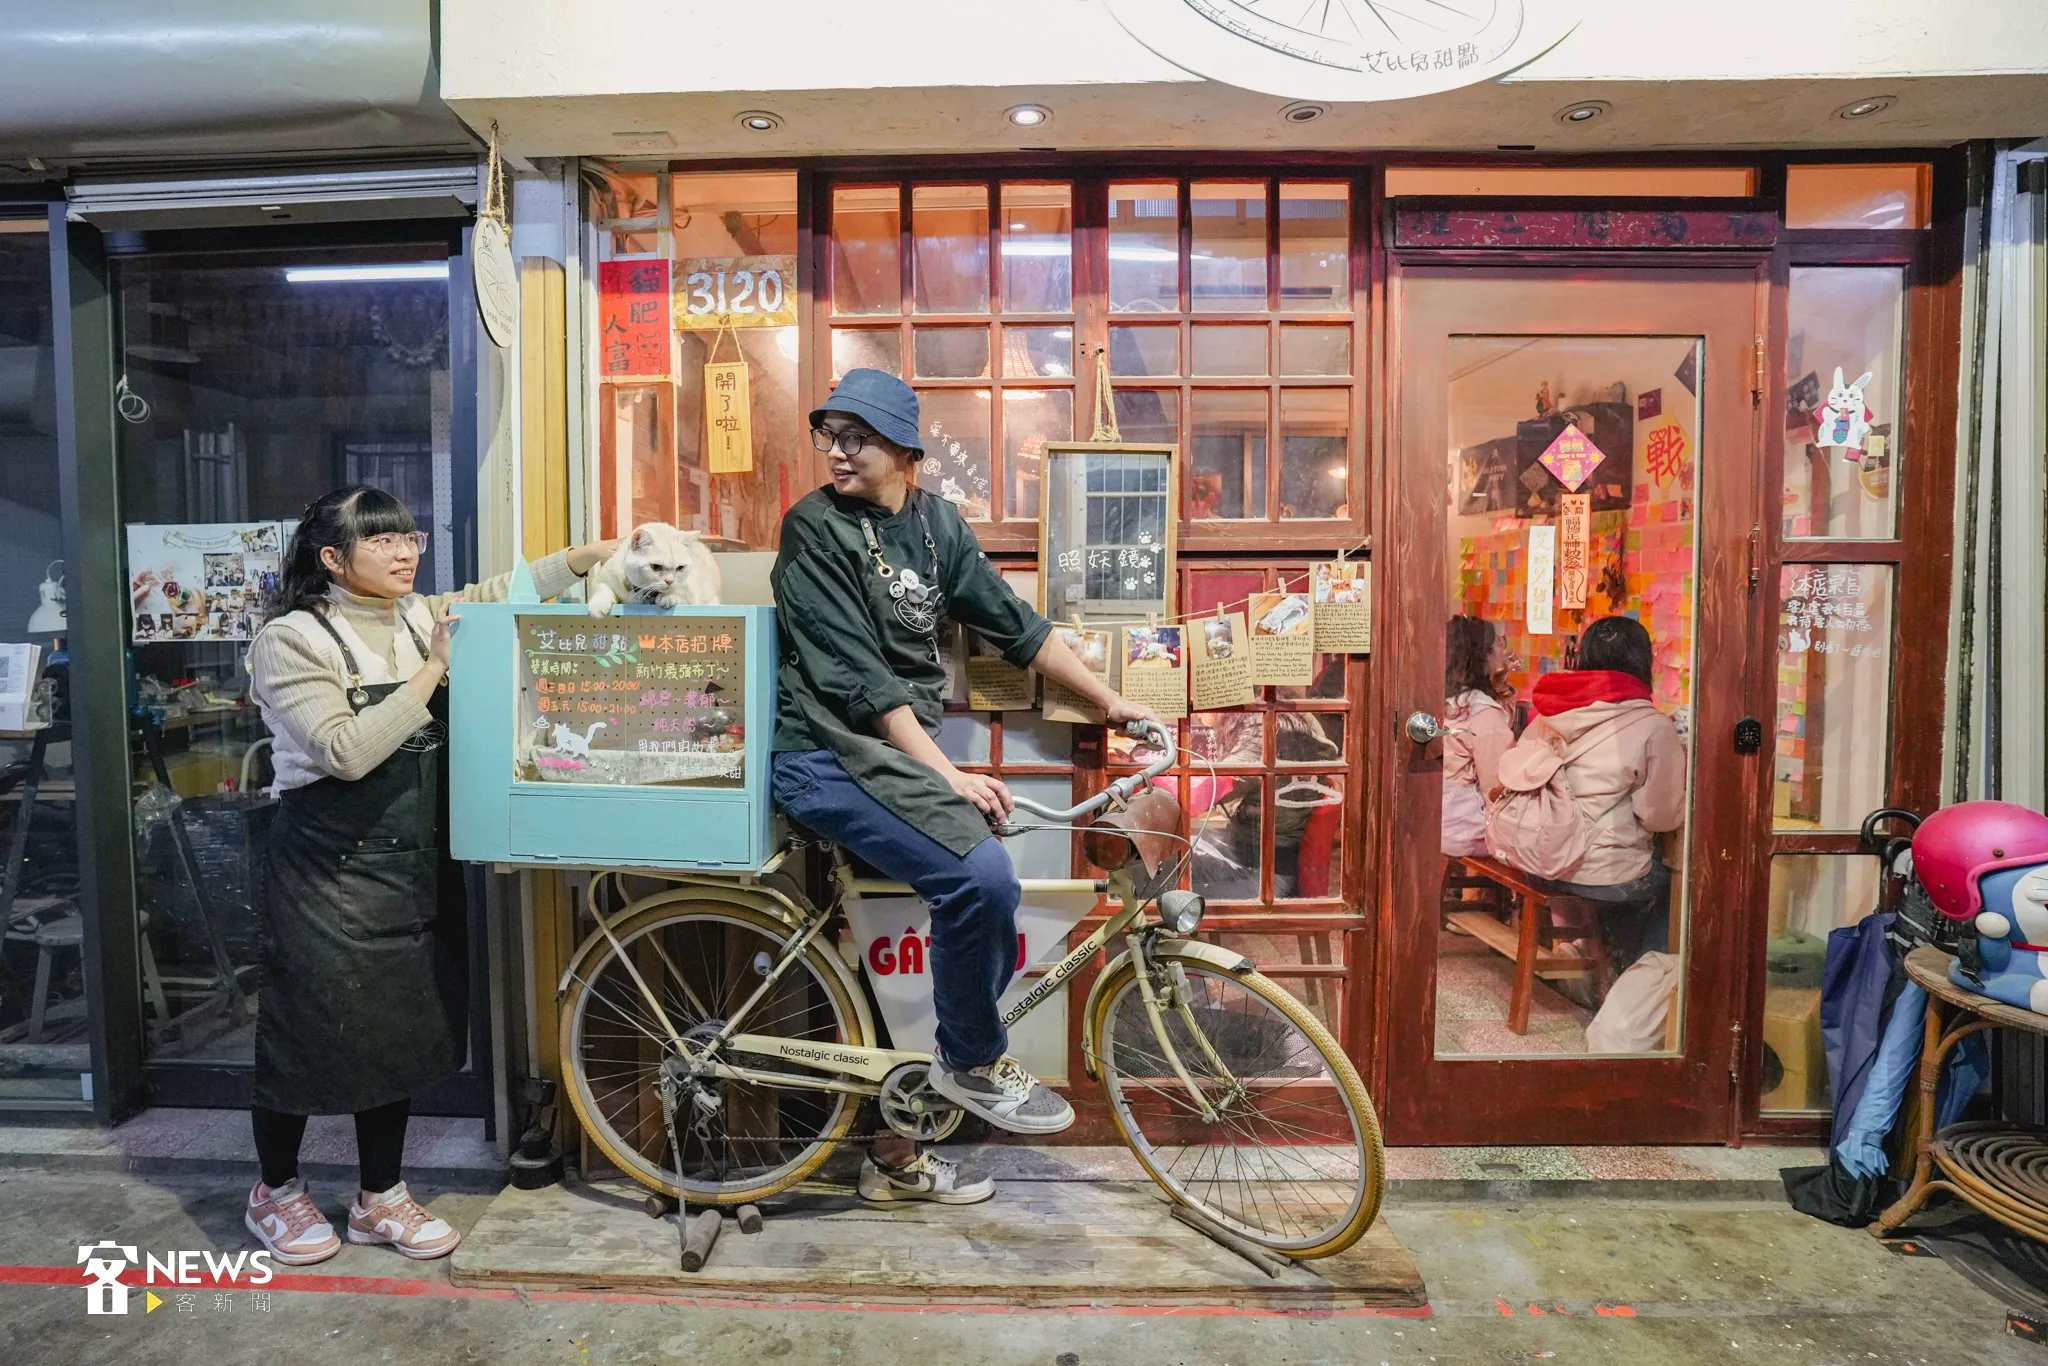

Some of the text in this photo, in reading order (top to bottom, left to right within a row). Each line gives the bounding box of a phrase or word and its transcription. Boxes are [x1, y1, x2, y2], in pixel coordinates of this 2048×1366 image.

[1360, 42, 1481, 73] 艾比兒甜點
[687, 269, 784, 316] 3120
[1058, 548, 1141, 572] 照妖鏡
[1796, 574, 1861, 597] 本店宗旨
[538, 629, 627, 652] 艾比兒甜點
[657, 634, 733, 654] 本店招牌
[1055, 940, 1098, 979] classic
[780, 1045, 870, 1066] Nostalgic classic
